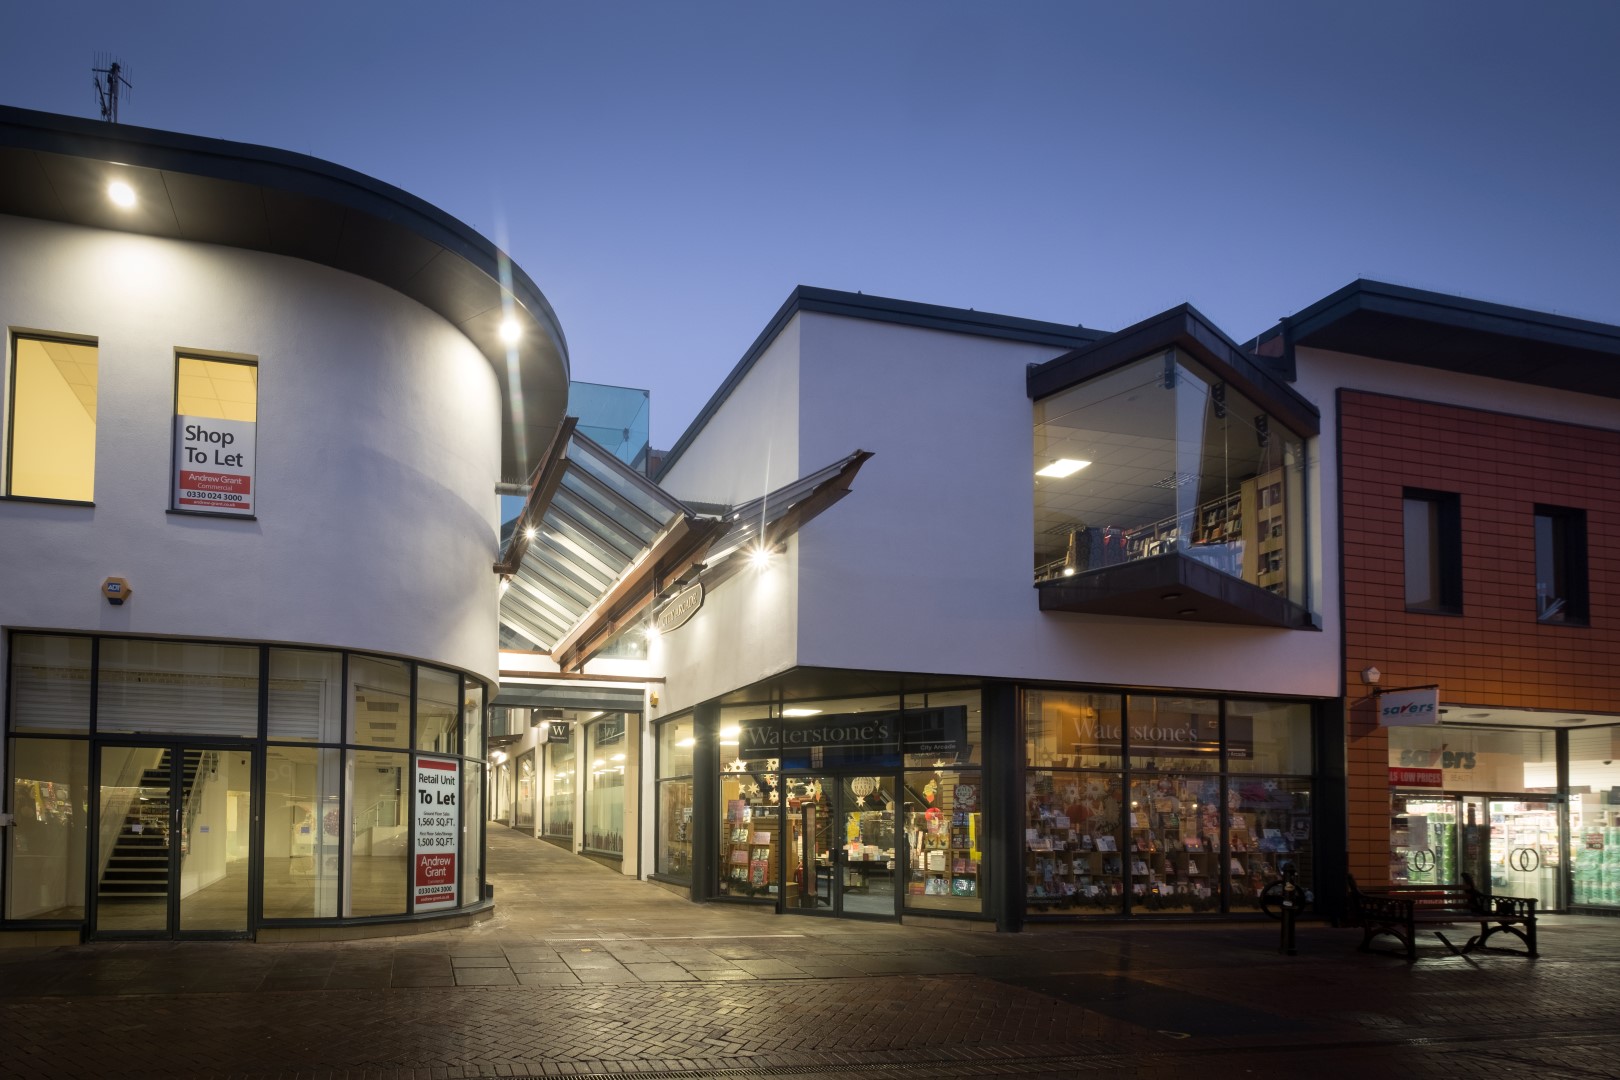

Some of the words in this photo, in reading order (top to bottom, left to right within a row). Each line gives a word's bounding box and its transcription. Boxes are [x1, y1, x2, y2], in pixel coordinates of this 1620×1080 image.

[185, 425, 234, 448] Shop
[185, 447, 207, 463] To
[215, 450, 243, 467] Let
[188, 473, 220, 483] Andrew
[220, 475, 243, 485] Grant
[197, 482, 233, 491] Commercial
[186, 490, 206, 499] 0330
[207, 492, 222, 500] 024
[223, 493, 243, 502] 3000
[1383, 701, 1434, 716] savers
[552, 725, 566, 736] W
[748, 720, 889, 746] Waterstone's
[418, 773, 439, 785] Retail
[440, 775, 456, 786] Unit
[1400, 772, 1416, 783] LOW
[1416, 772, 1441, 784] PRICES
[418, 789, 433, 805] To
[436, 790, 456, 806] Let
[418, 818, 435, 827] 1,560
[417, 837, 434, 848] 1,500
[420, 855, 451, 867] Andrew
[425, 866, 447, 877] Grant
[418, 887, 430, 895] 0330
[440, 885, 453, 893] 3000
